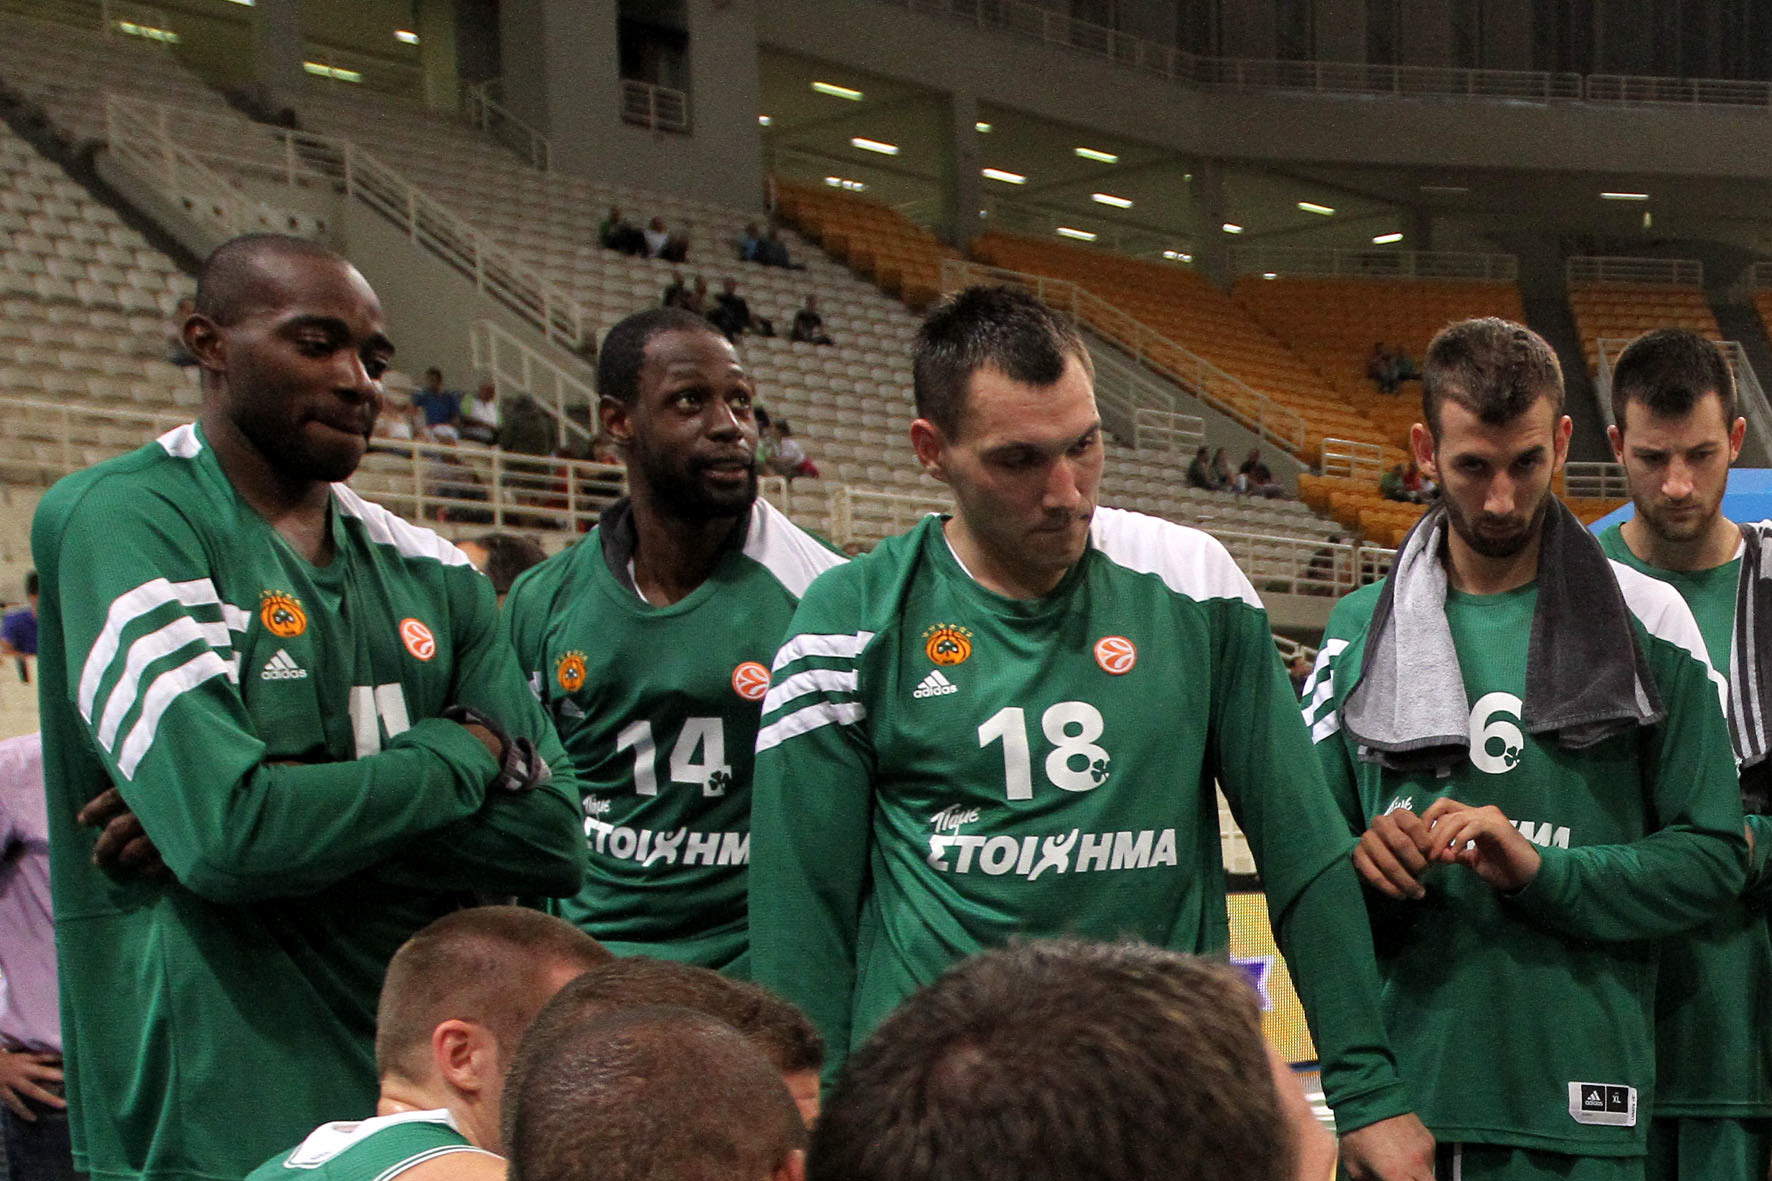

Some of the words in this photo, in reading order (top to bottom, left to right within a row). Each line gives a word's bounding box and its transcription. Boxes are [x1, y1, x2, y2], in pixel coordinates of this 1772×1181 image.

[261, 667, 307, 680] adidas
[913, 684, 958, 698] adidas
[978, 701, 1110, 800] 18
[1469, 691, 1525, 774] 6
[617, 717, 732, 797] 14
[1612, 1096, 1621, 1104] XL
